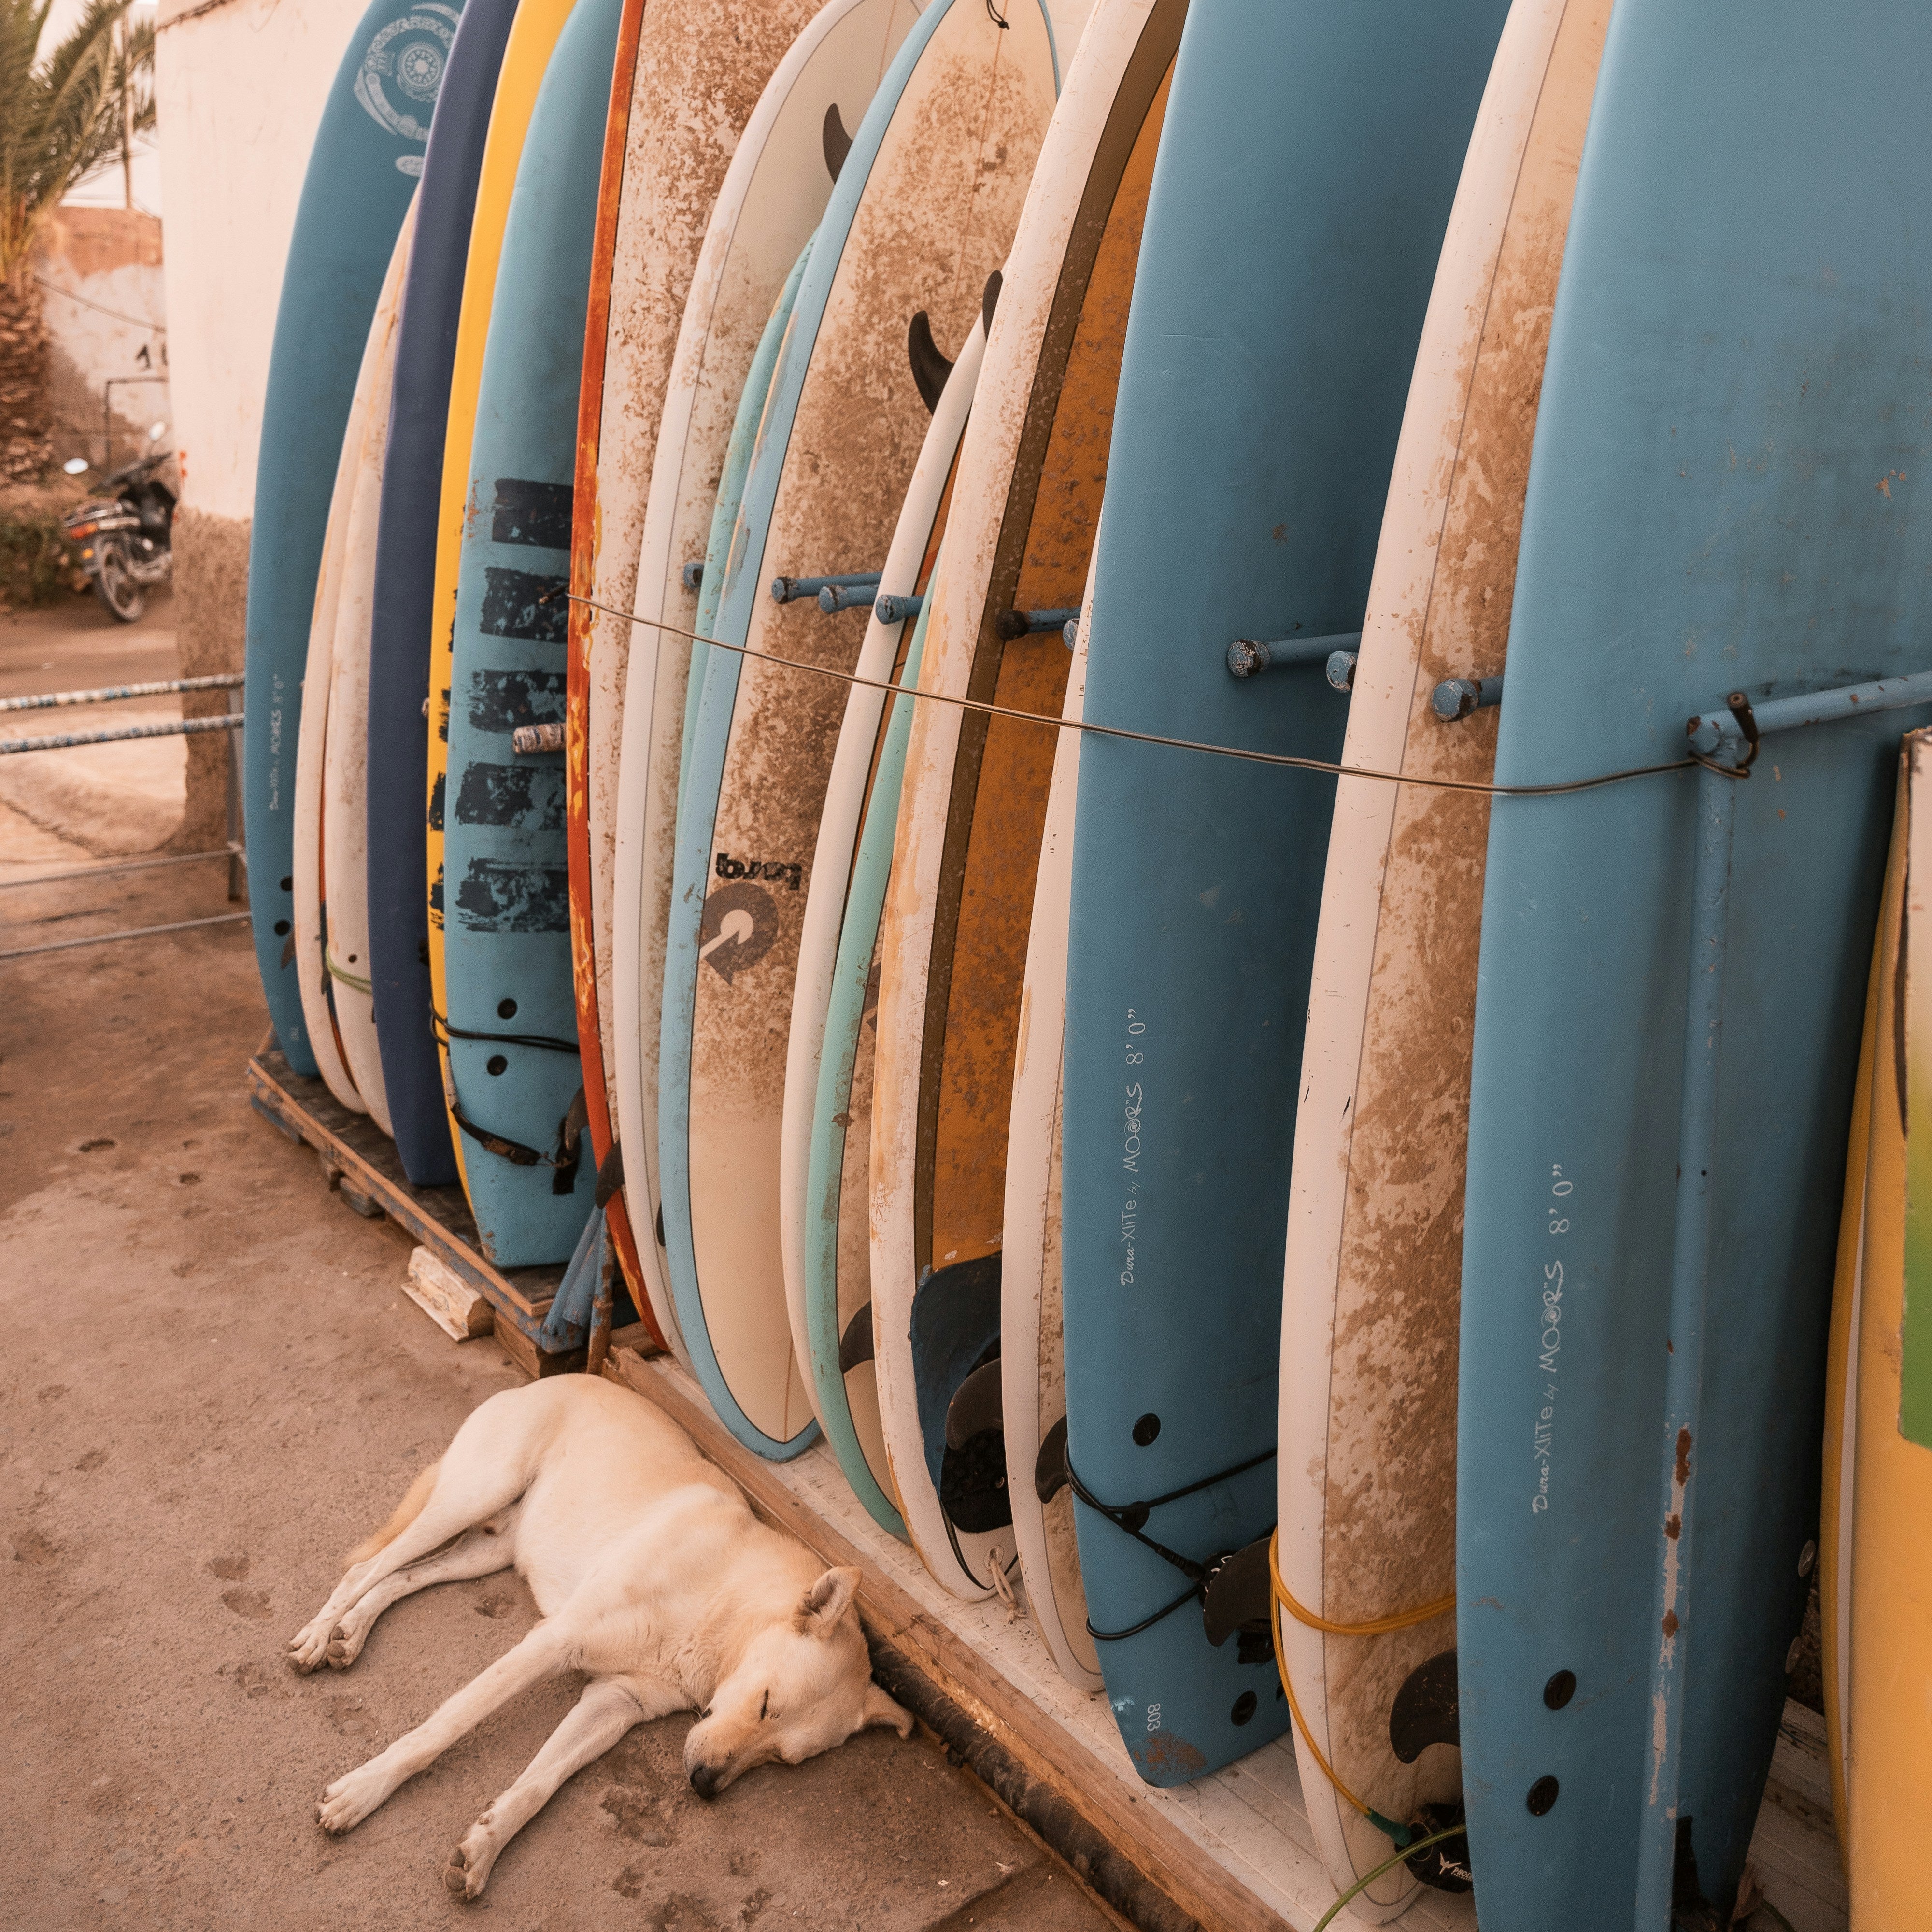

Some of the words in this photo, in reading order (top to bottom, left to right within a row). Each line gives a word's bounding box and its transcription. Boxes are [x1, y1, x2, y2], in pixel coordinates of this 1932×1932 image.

[715, 852, 802, 890] torq
[1127, 1181, 1140, 1195] by
[1543, 1384, 1558, 1400] by
[1147, 1703, 1161, 1732] 803
